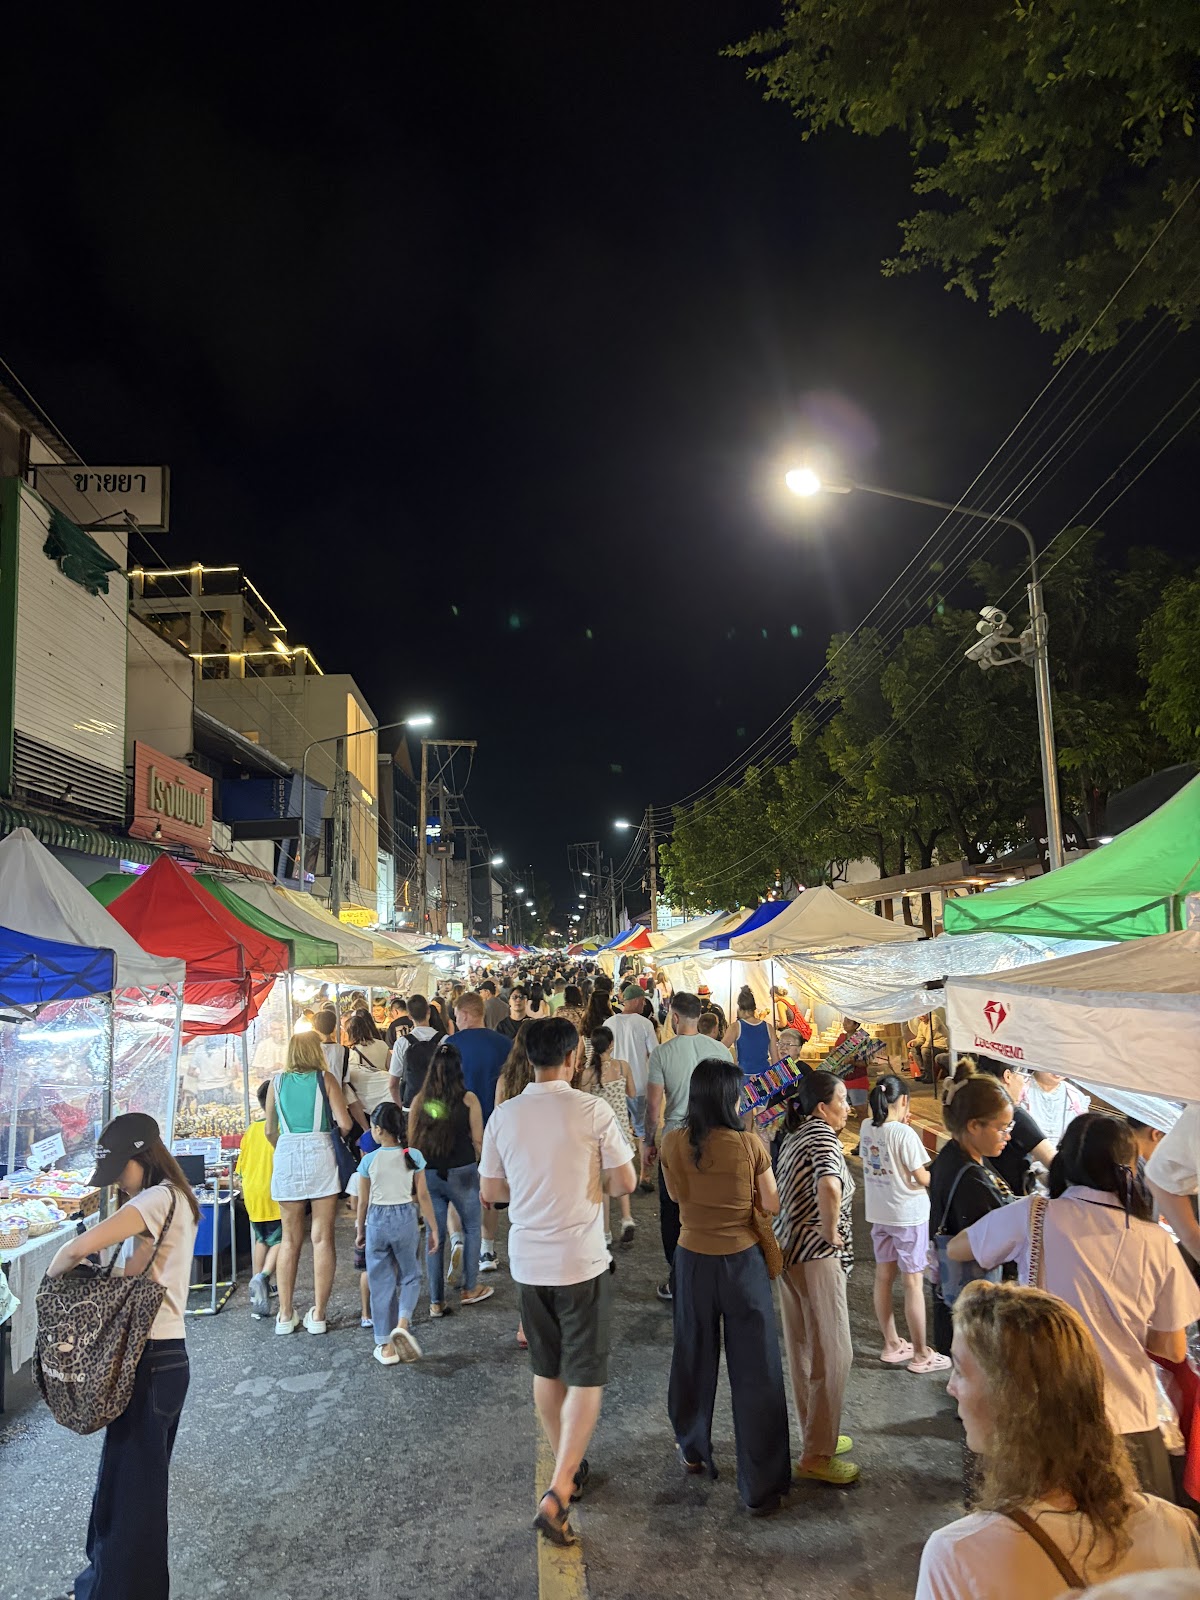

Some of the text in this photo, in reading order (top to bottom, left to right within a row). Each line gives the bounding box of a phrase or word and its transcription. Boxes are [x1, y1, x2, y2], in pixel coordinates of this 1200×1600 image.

[73, 473, 146, 493] ขายยา
[149, 765, 208, 828] โรงพิมพ์
